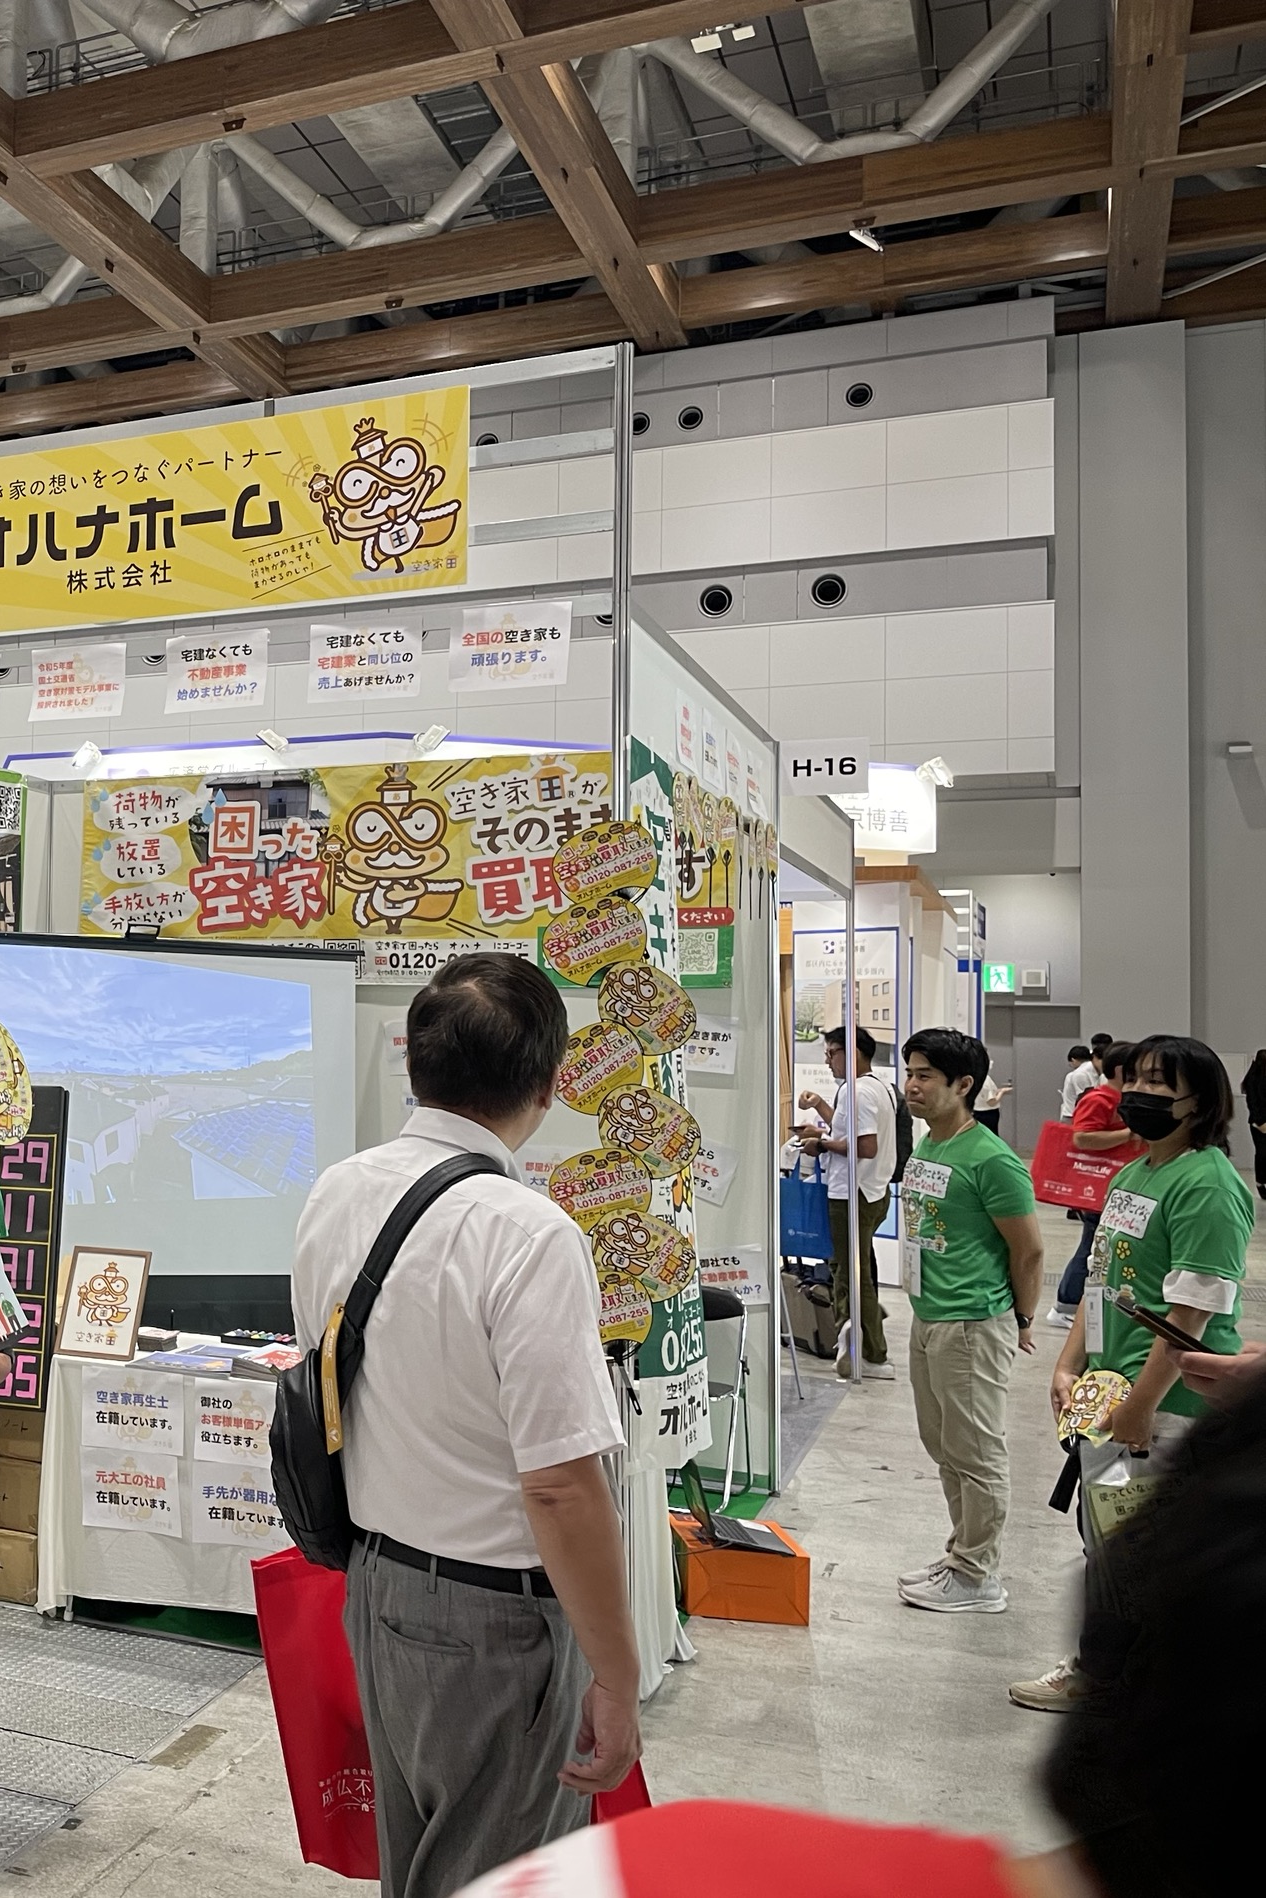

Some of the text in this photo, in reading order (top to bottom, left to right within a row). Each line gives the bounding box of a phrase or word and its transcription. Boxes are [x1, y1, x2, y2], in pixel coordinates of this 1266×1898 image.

[250, 552, 311, 579] 荷物があっても
[67, 559, 172, 594] 株式会社
[326, 630, 405, 649] 宅建なくても
[462, 626, 562, 649] 全国の空き家も
[181, 642, 253, 662] 宅建なくても
[318, 650, 413, 669] 宅建業と同じ位の
[471, 649, 548, 668] 頑張ります。
[38, 661, 74, 672] 令和5年度
[187, 662, 247, 681] 不動産事業
[38, 674, 75, 685] 国土交通省
[792, 756, 857, 778] H-16
[114, 790, 181, 814] 荷物が
[109, 811, 180, 830] 残っている
[844, 806, 909, 833] 京博善
[213, 806, 315, 855] 困った
[116, 838, 161, 862] 放置
[116, 863, 166, 878] している
[587, 851, 654, 884] 0120-087-255
[104, 889, 188, 915] 手放し方が
[193, 860, 321, 928] 空き家
[681, 913, 726, 924] ください
[375, 941, 439, 951] 空き家で困ったら
[449, 942, 482, 951] オハナ
[577, 926, 643, 960] 0120-087-255
[693, 1030, 732, 1042] 空き家が
[583, 1047, 638, 1092] 0120-087-255
[581, 1184, 648, 1208] 0120-087-255
[700, 1256, 741, 1268] 御社でも
[95, 1390, 169, 1410] 空き家再生士
[200, 1396, 233, 1410] 御社の
[95, 1411, 173, 1431] 在籍しています。
[200, 1431, 258, 1449] 役立ちます。
[95, 1470, 167, 1491] 元大工の社員
[95, 1492, 172, 1511] 在籍しています。
[202, 1485, 279, 1507] 手先が器用な
[207, 1507, 285, 1530] 在籍しています
